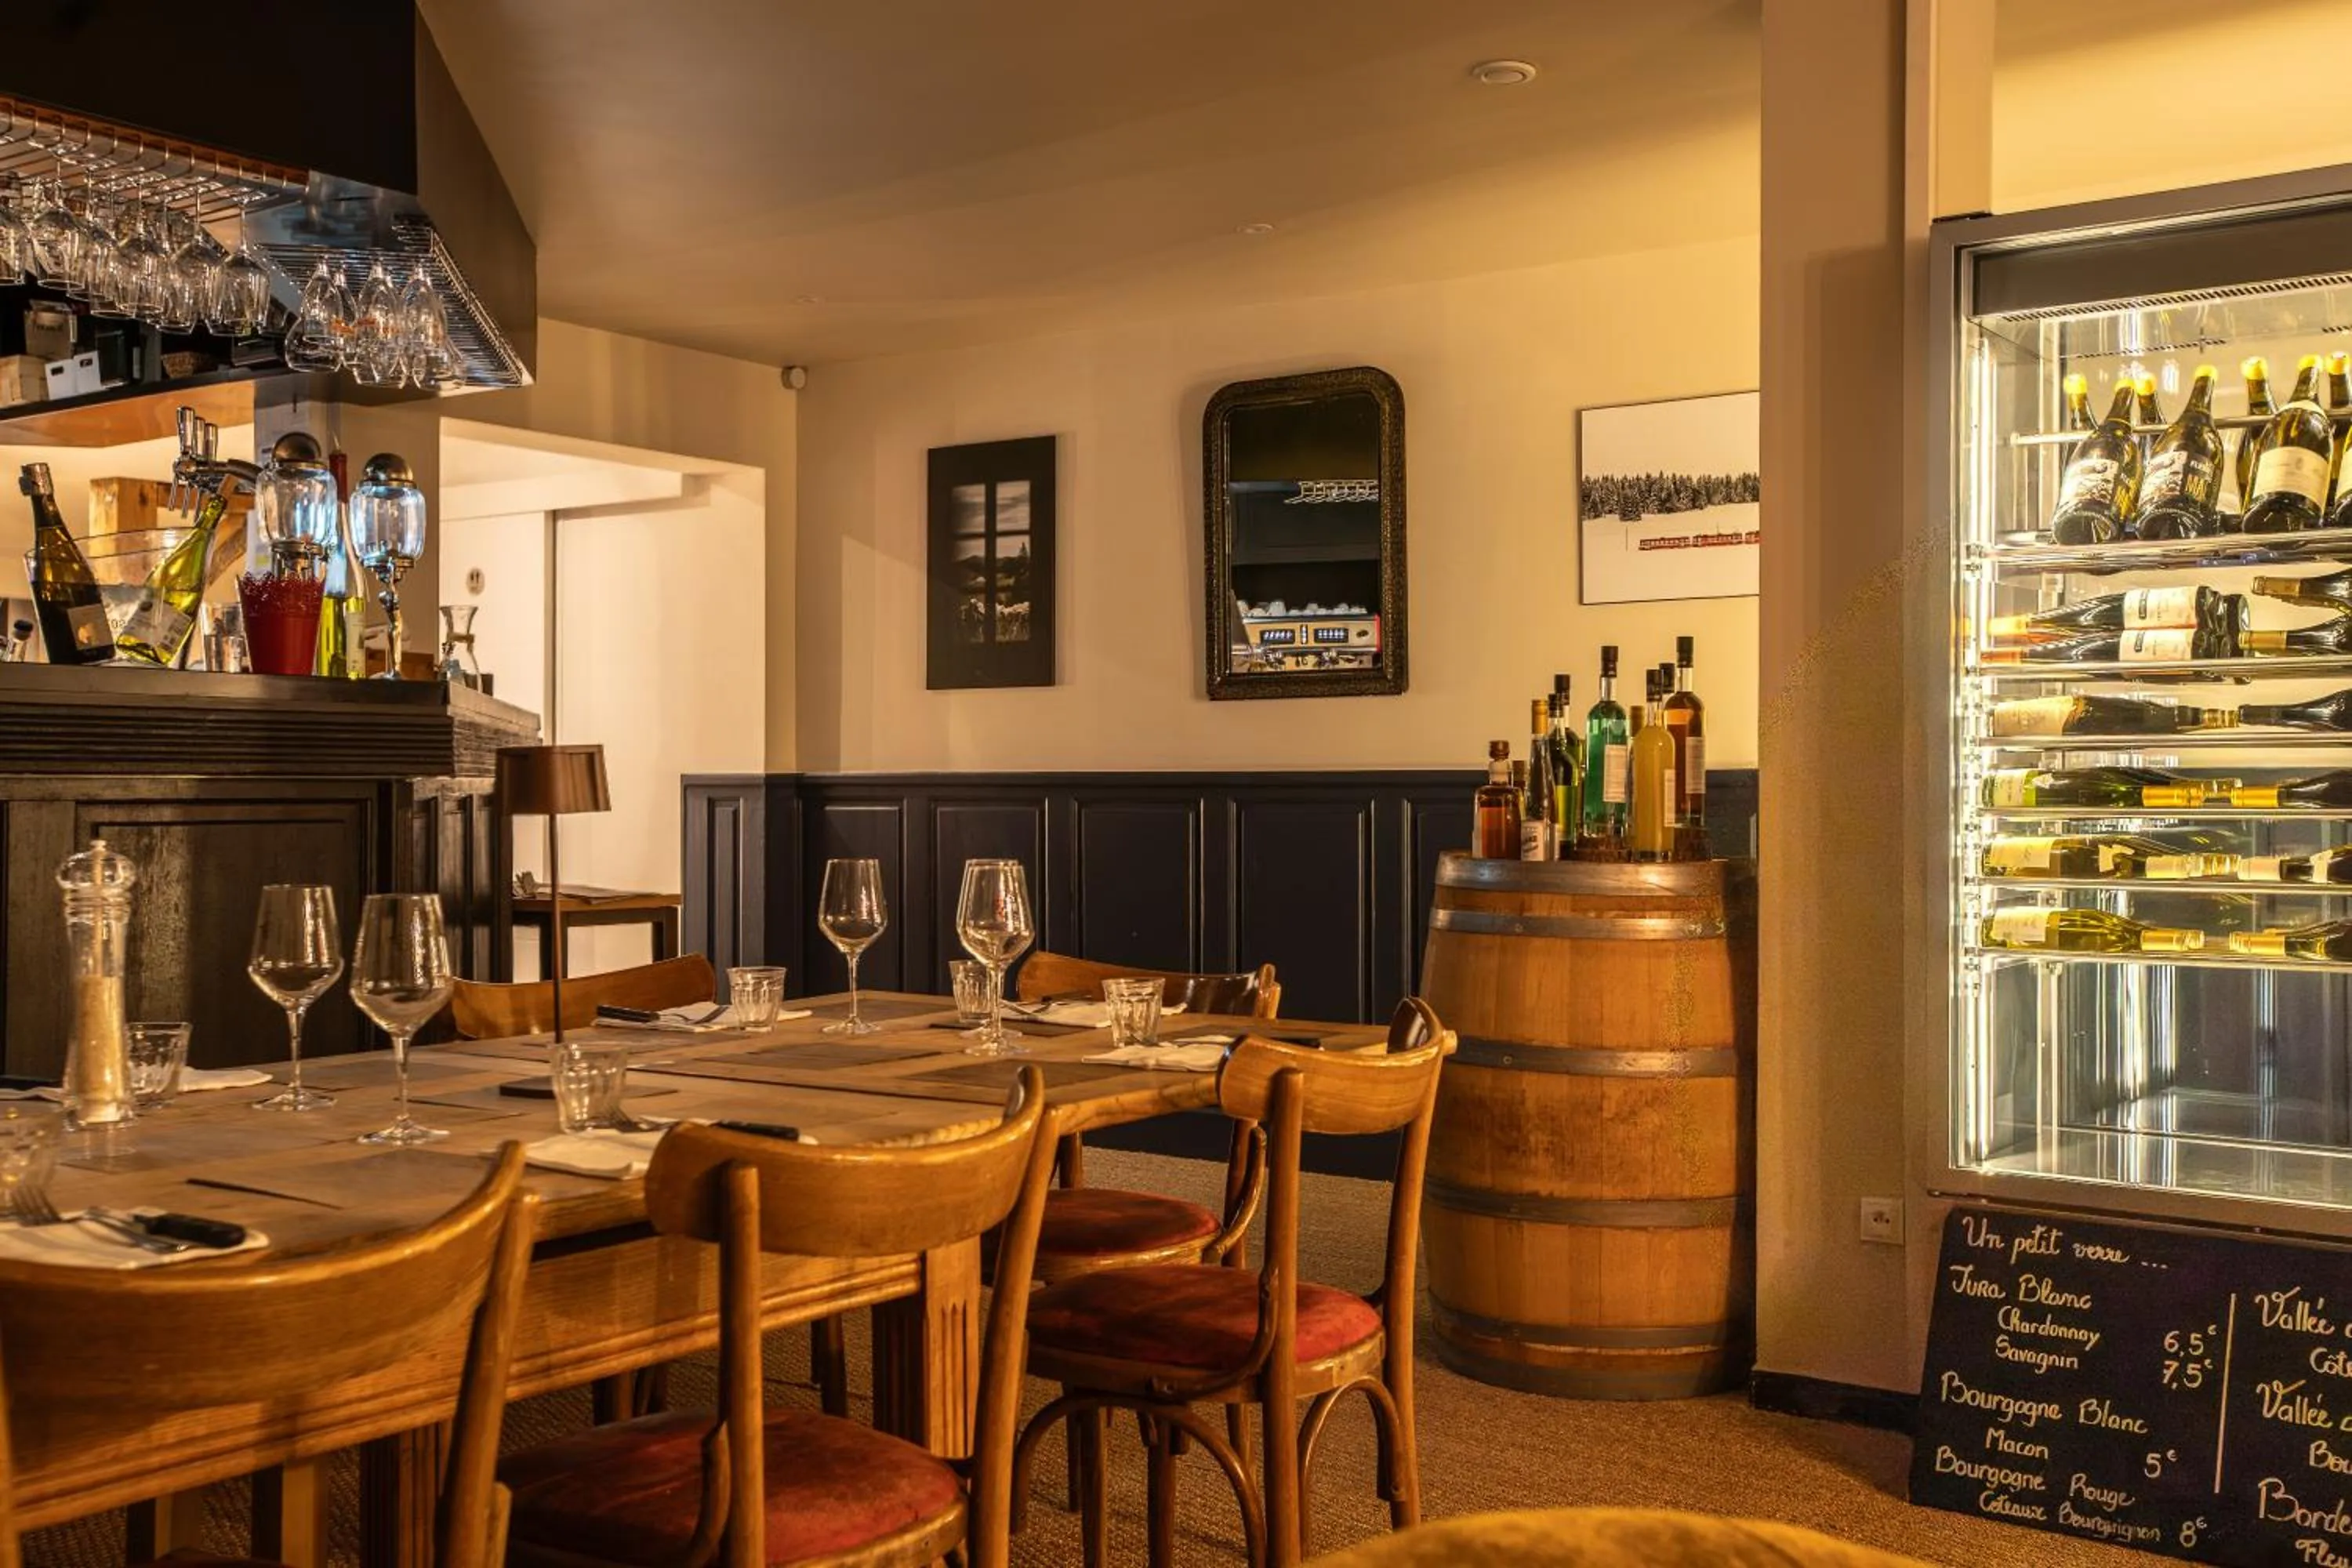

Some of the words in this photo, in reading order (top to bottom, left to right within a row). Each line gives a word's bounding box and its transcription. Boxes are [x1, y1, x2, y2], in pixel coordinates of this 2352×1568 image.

[1962, 1216, 2005, 1249] Un
[2010, 1224, 2063, 1265] petit
[2071, 1242, 2130, 1264] verre
[2018, 1273, 2092, 1309] Blanc
[1997, 1305, 2101, 1352] Chardonnay
[1994, 1334, 2078, 1374] Savagnin
[1940, 1370, 2063, 1428] Bourgogne
[2078, 1398, 2149, 1435] Blanc
[1934, 1445, 2045, 1493] Bourgogne
[2069, 1472, 2136, 1512] Rouge
